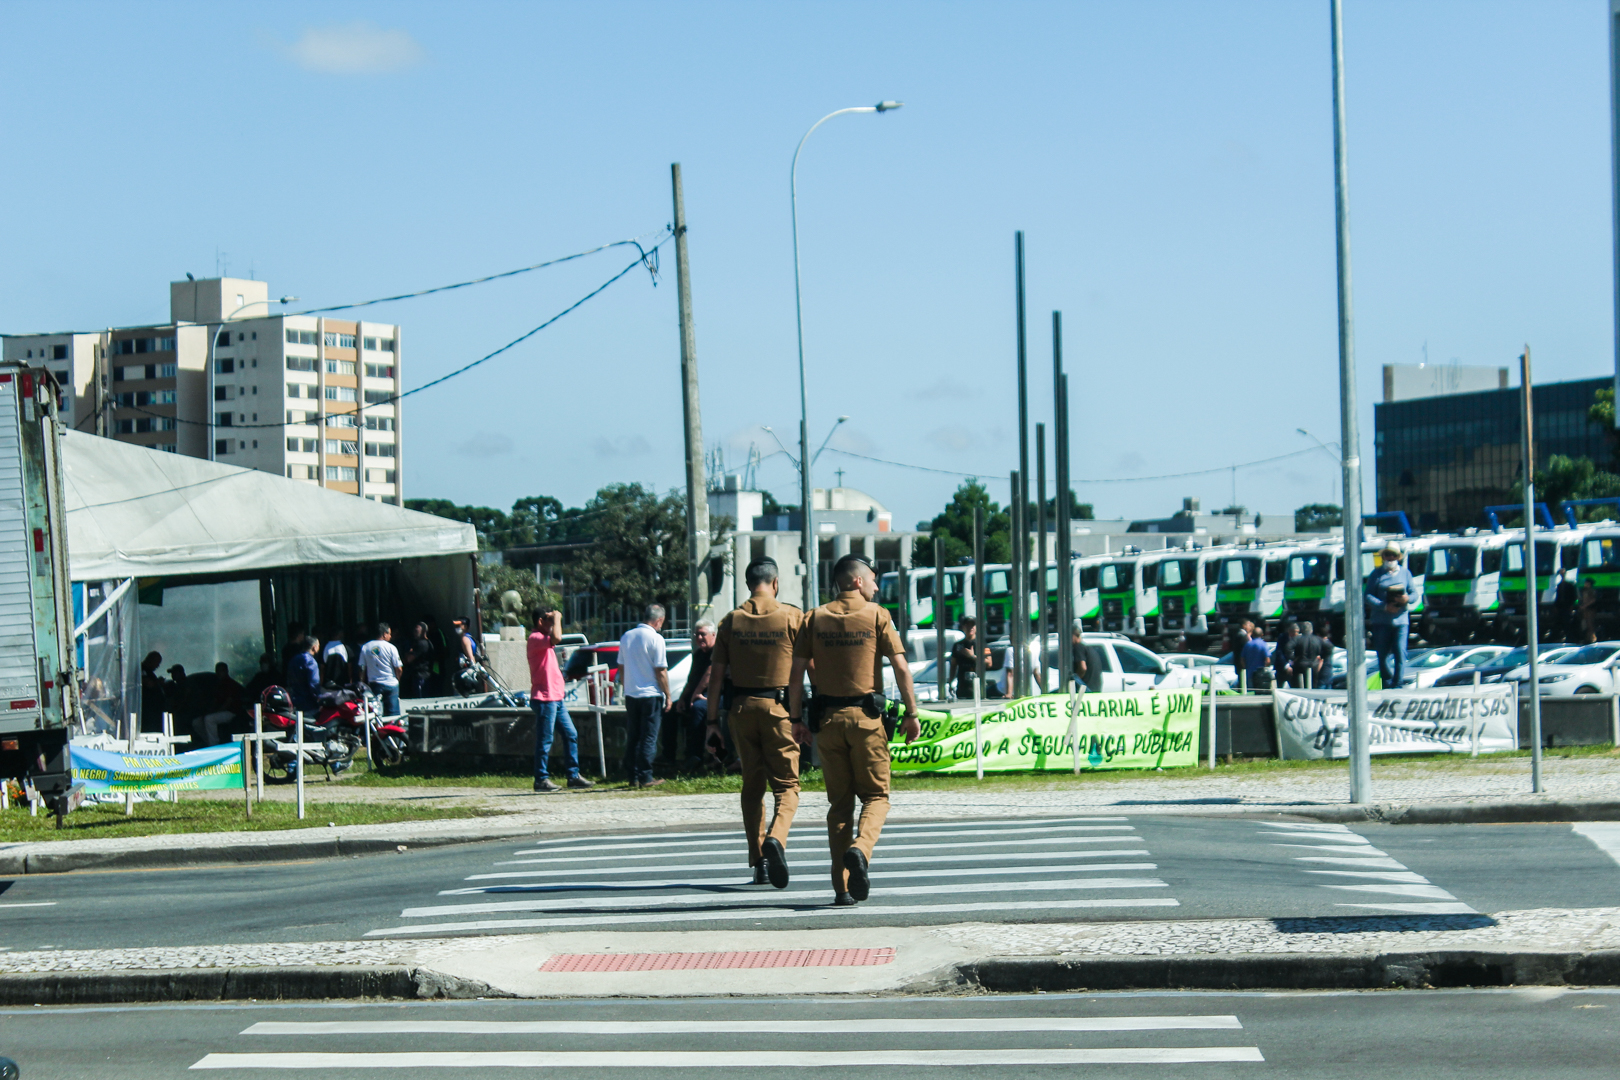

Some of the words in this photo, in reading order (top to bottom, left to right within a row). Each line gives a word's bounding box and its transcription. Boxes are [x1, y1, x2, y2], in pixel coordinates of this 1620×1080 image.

[843, 631, 871, 639] MILITAR
[1064, 697, 1144, 718] SALARIAL
[1151, 692, 1161, 715] É
[1167, 693, 1194, 713] UM
[1372, 698, 1402, 721] AS
[998, 737, 1009, 755] A
[1017, 733, 1126, 763] SEGURANÇA
[1132, 729, 1193, 755] PÚBLICA
[80, 768, 108, 780] NEGRO
[140, 783, 168, 792] SOMOS
